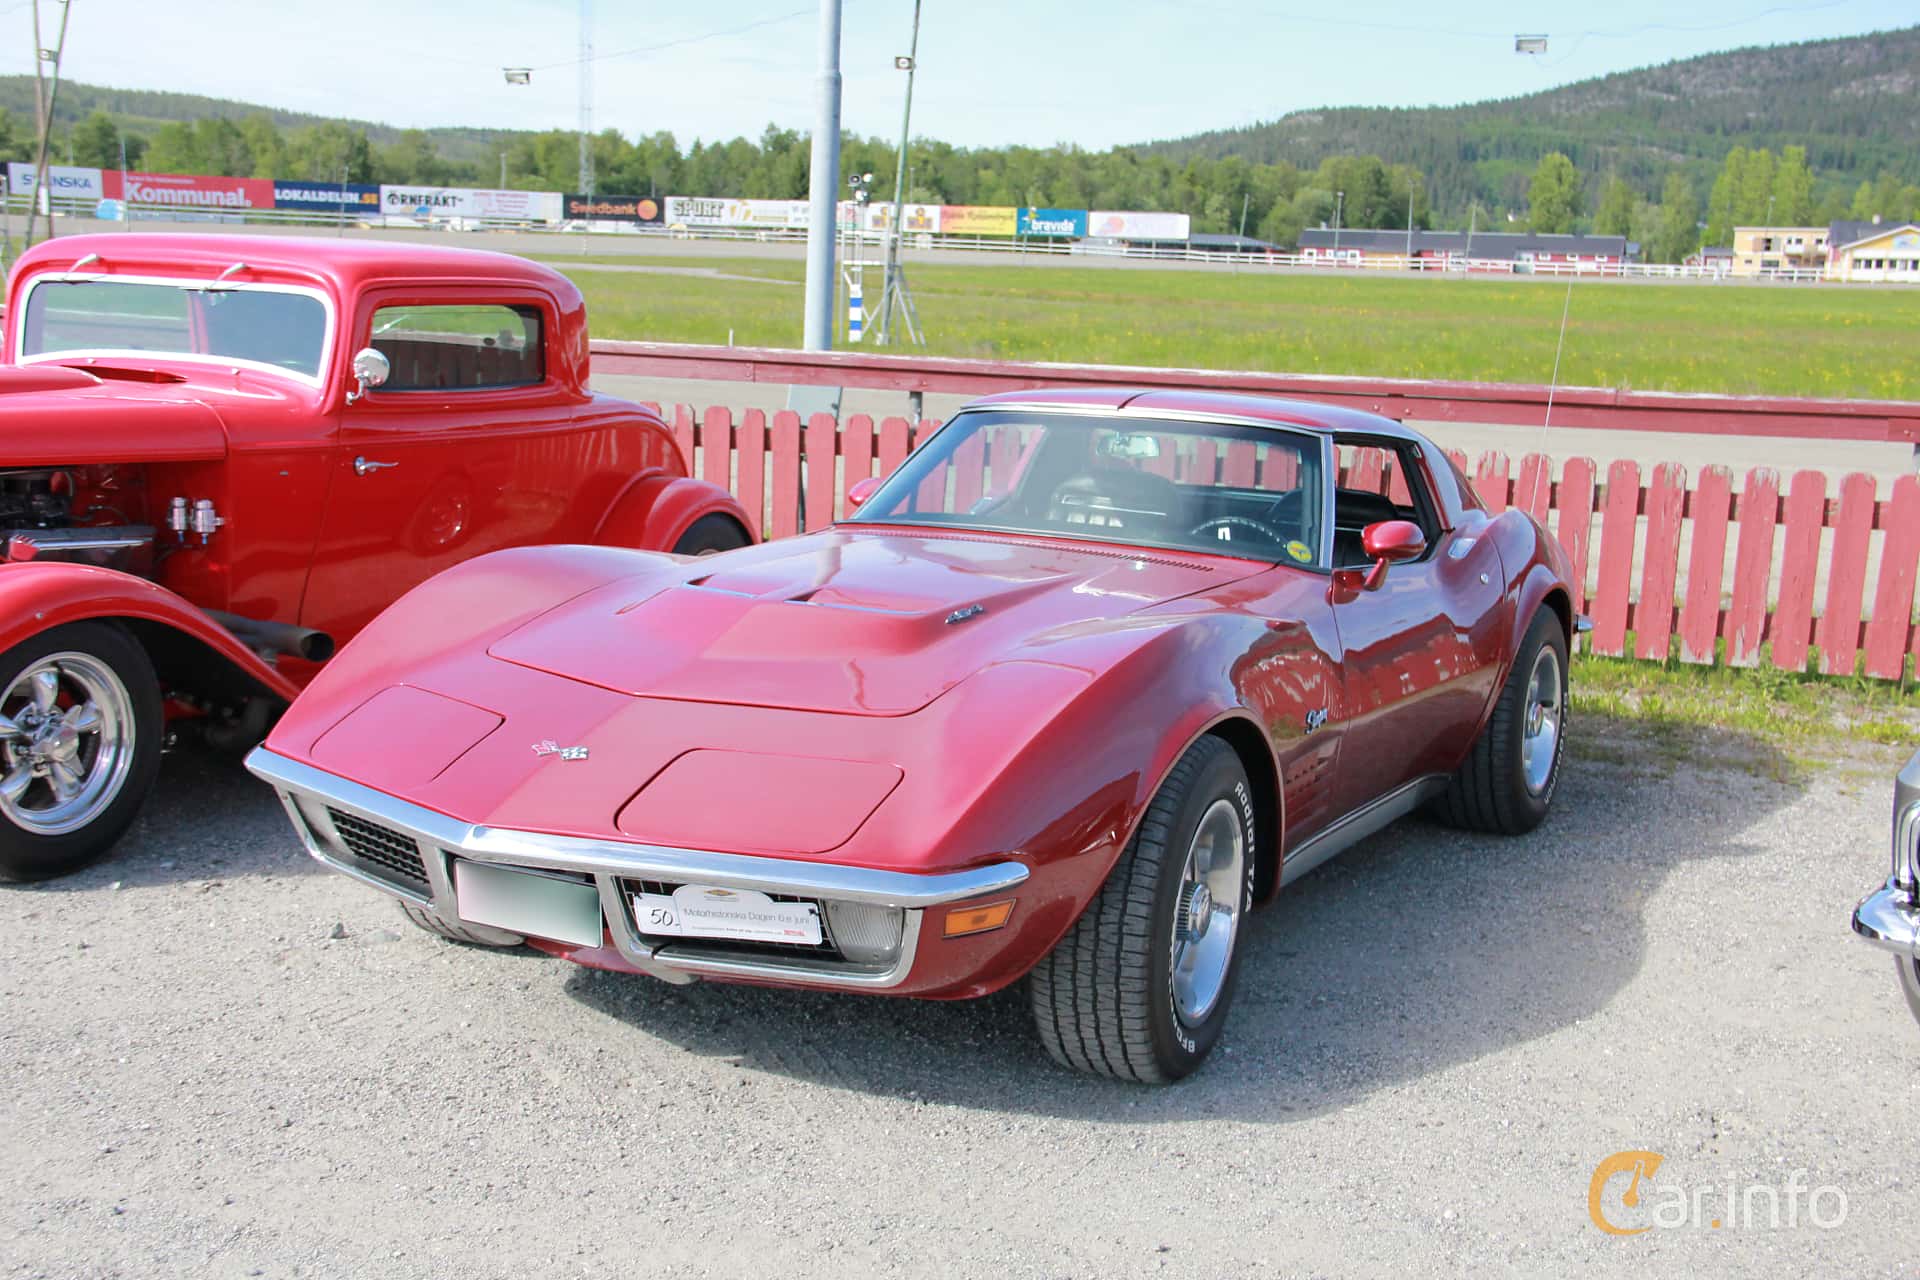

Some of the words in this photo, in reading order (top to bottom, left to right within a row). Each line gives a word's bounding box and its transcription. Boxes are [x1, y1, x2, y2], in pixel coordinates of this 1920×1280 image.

[22, 173, 92, 189] SNSKA
[570, 201, 636, 215] Swedbank
[1235, 781, 1256, 853] Radial
